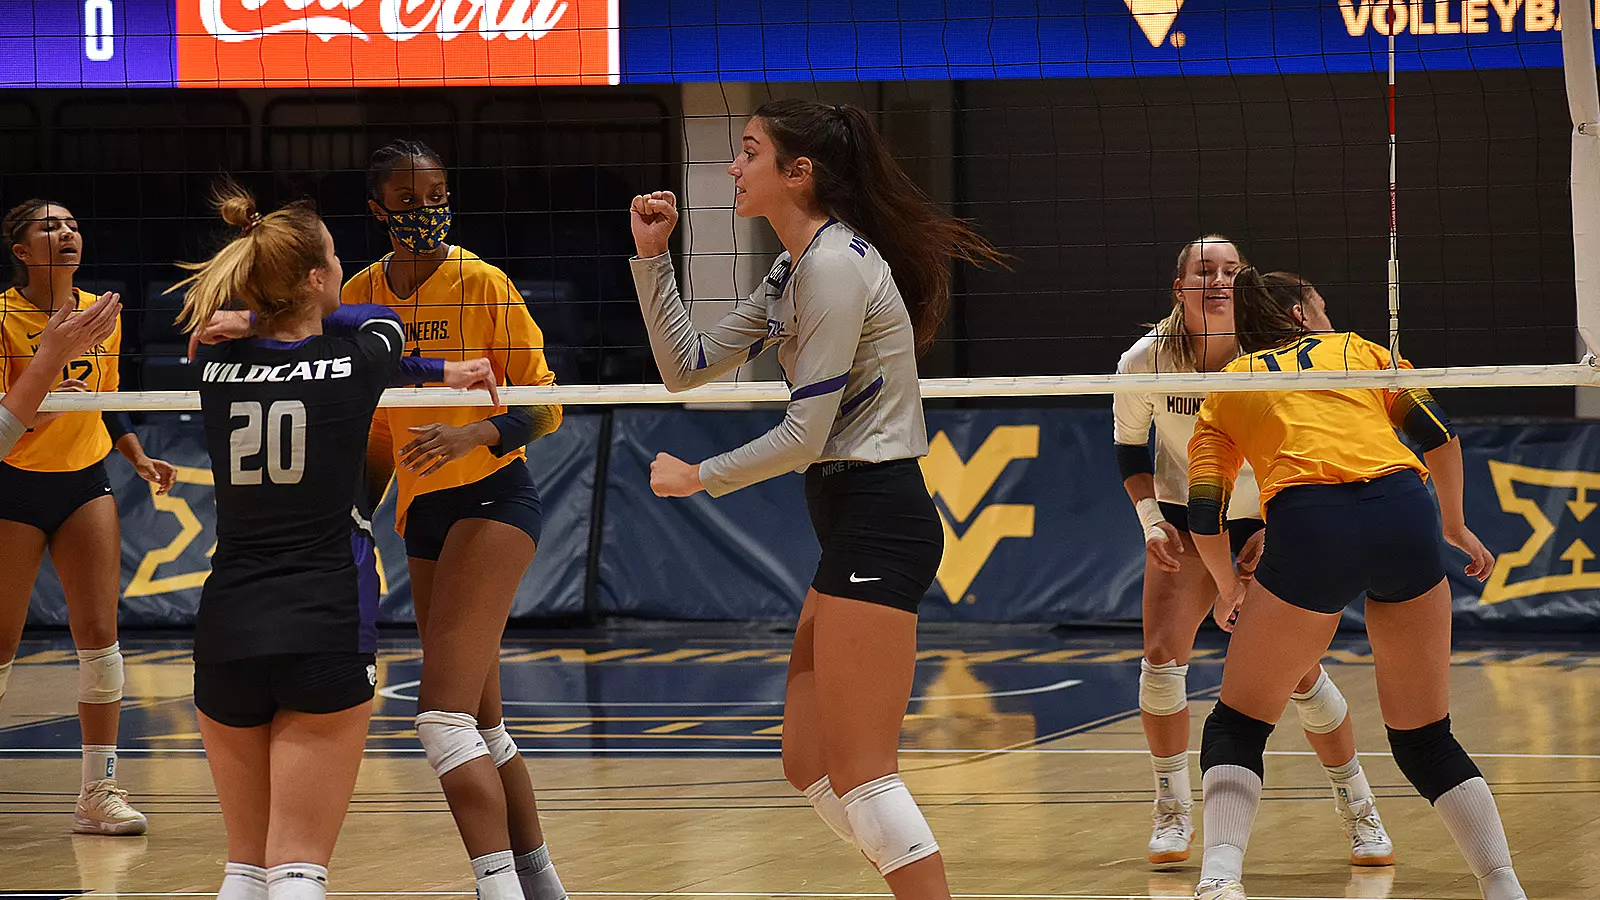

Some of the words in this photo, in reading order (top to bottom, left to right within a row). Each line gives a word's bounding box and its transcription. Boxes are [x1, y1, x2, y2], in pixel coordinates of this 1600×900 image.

[85, 0, 114, 61] 0
[1339, 0, 1600, 36] VOLLEYB
[202, 356, 352, 383] WILDCATS
[229, 400, 307, 485] 20
[822, 461, 845, 477] NIKE
[847, 460, 871, 470] PR
